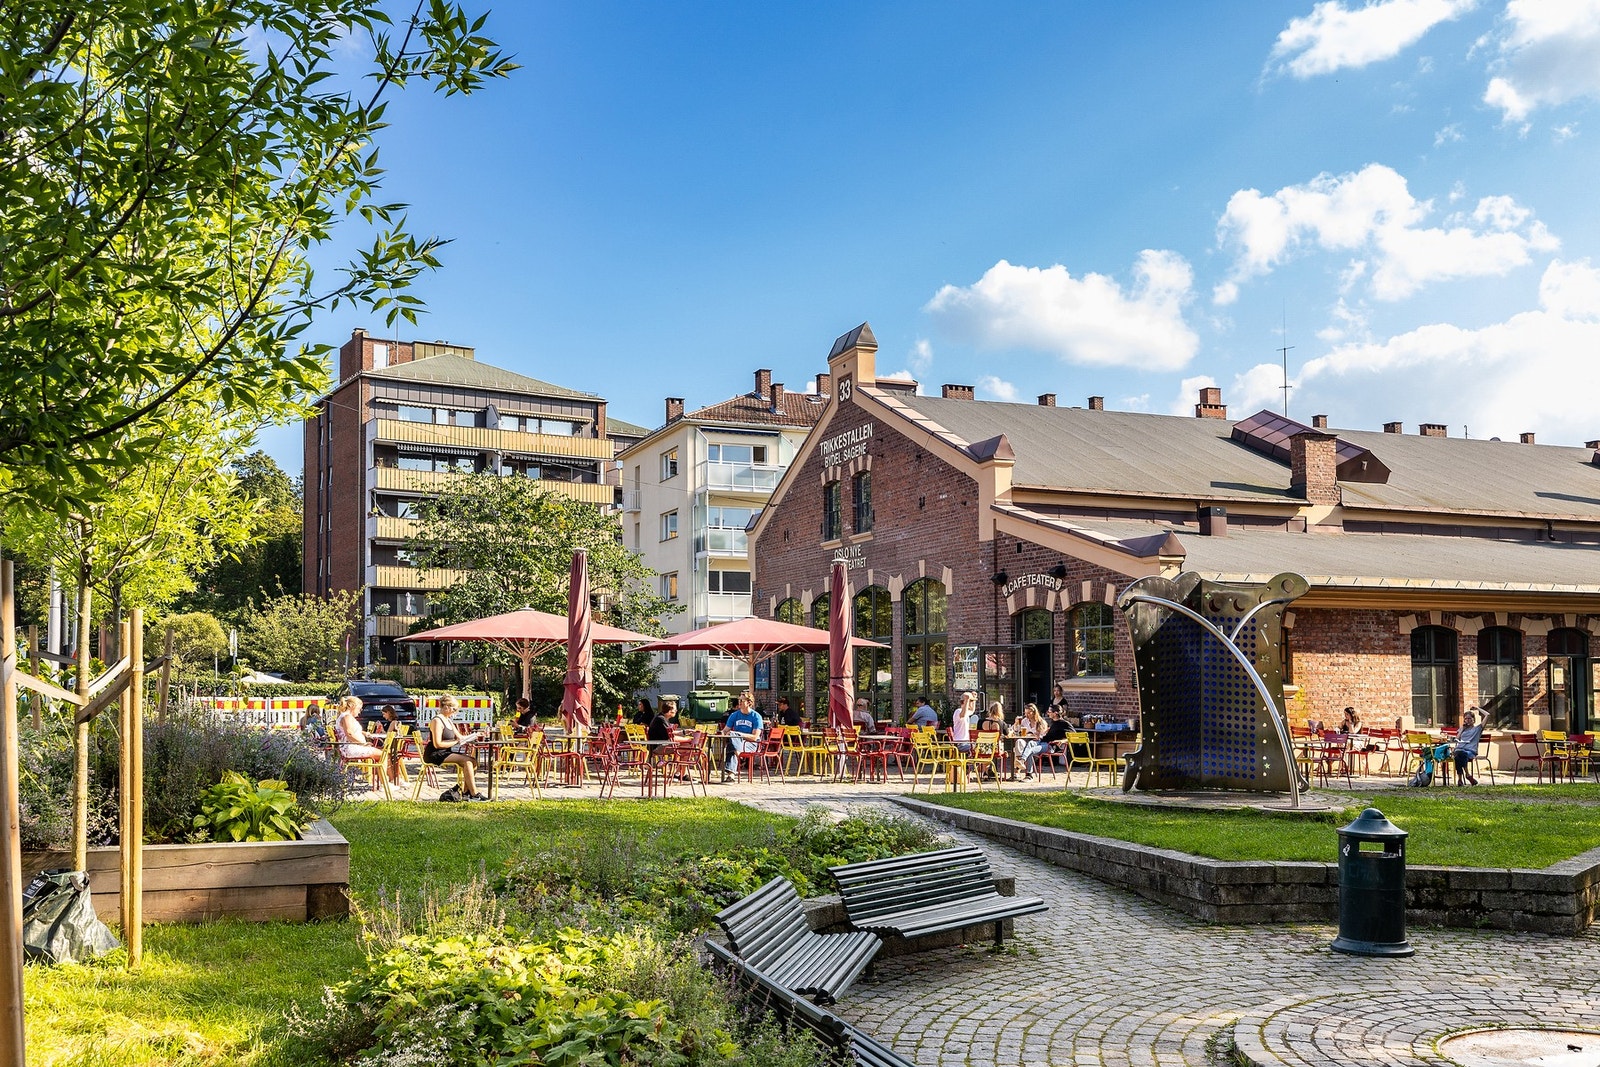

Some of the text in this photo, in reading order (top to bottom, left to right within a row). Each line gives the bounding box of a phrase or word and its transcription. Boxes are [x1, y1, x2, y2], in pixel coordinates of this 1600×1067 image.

[840, 380, 851, 401] 33
[820, 422, 873, 456] TRIKKESTALLEN
[824, 442, 867, 468] BYDEL SAGENE
